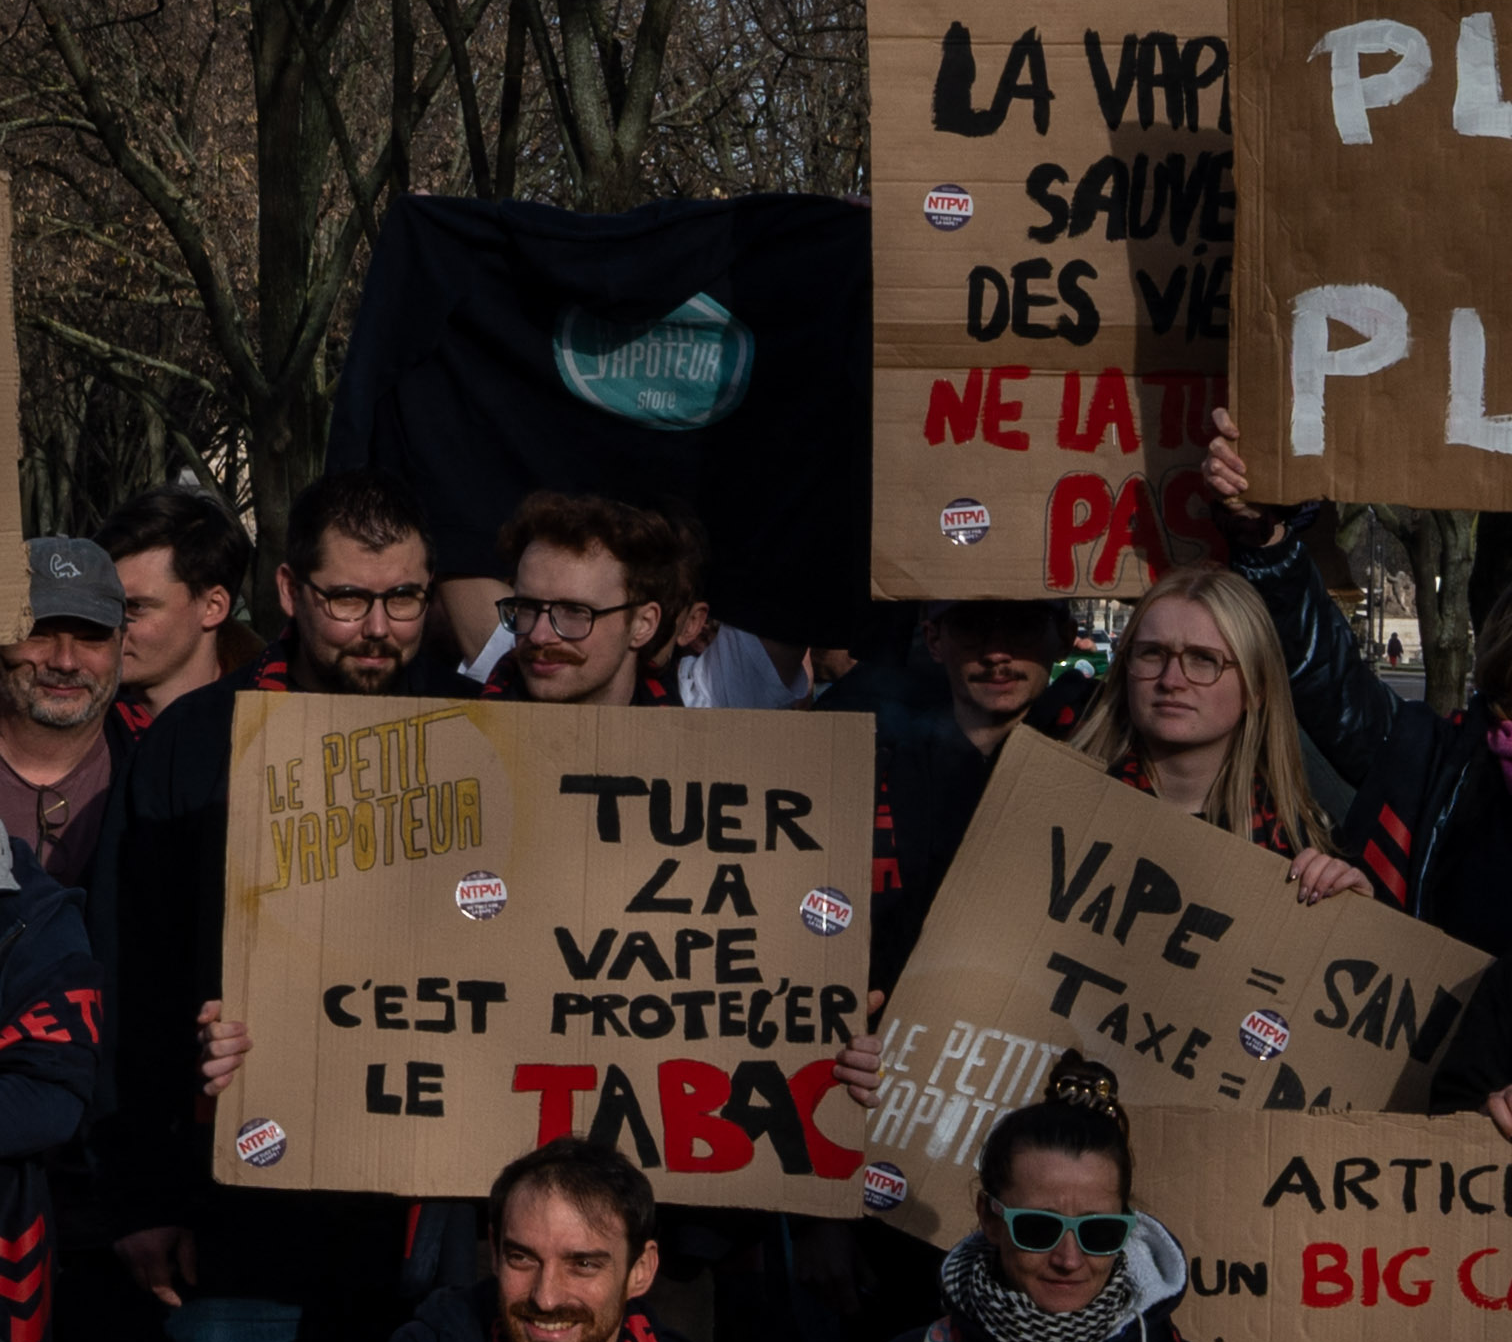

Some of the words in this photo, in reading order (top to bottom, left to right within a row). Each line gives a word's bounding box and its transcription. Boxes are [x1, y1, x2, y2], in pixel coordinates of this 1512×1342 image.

[931, 20, 1056, 138] LA
[966, 257, 1101, 348] DES
[924, 364, 1033, 452] NE
[1056, 367, 1140, 454] LA
[559, 773, 823, 854] TUER
[624, 858, 759, 918] LA
[1047, 826, 1234, 970] VAPE
[553, 926, 764, 985] VAPE
[1043, 936, 1212, 1094] TAXE
[365, 1060, 445, 1118] LE
[1301, 1242, 1433, 1308] BIG
